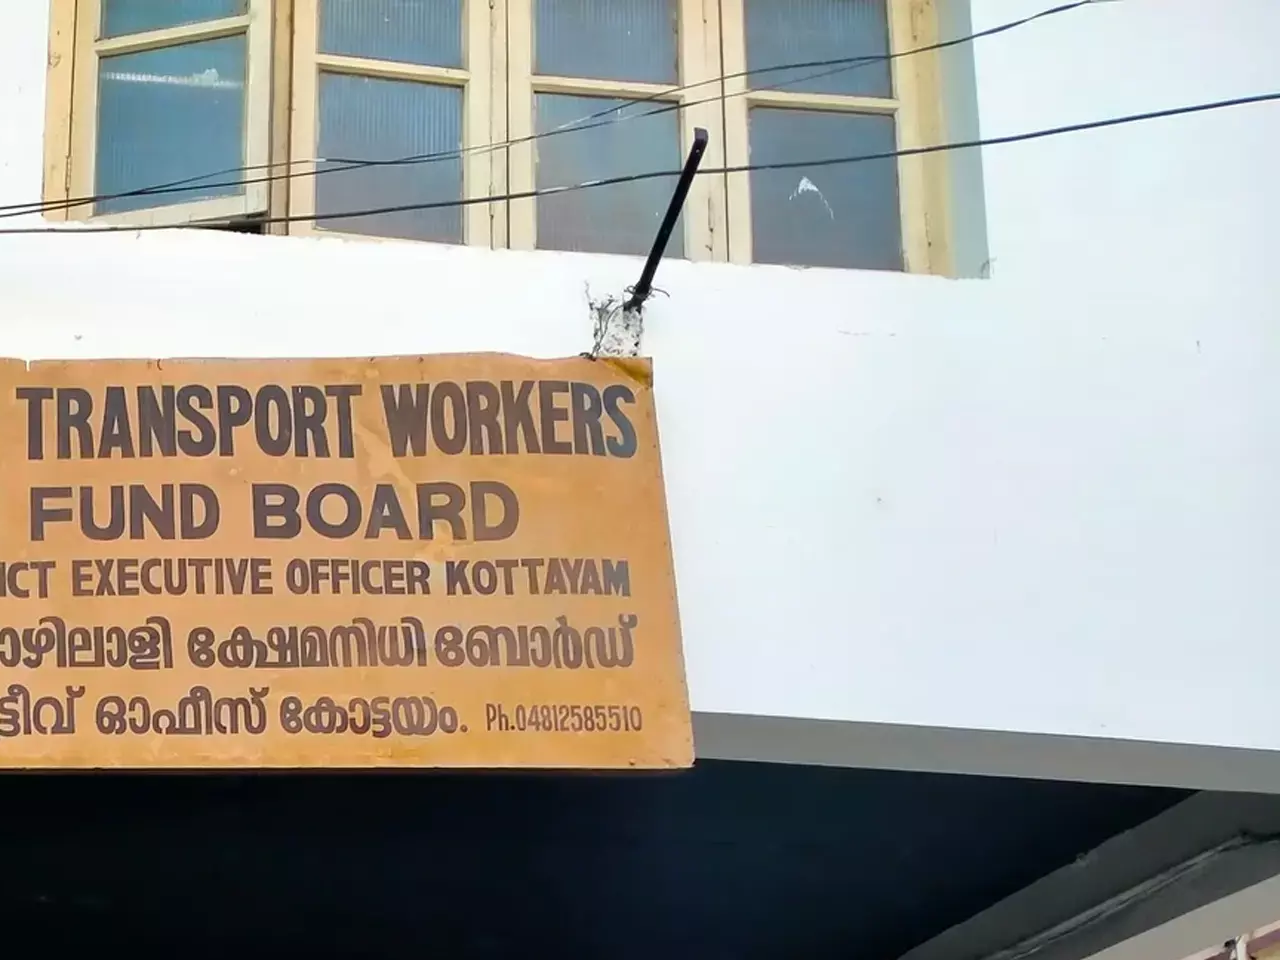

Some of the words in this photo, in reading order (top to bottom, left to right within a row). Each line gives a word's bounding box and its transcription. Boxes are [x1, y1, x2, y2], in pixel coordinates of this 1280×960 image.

[16, 384, 362, 460] TRANSPORT
[381, 379, 637, 458] WORKERS
[30, 483, 220, 541] FUND
[252, 481, 519, 541] BOARD
[72, 558, 273, 596] EXECUTIVE
[286, 559, 430, 595] OFFICER
[446, 558, 630, 596] KOTTAYAM
[187, 617, 427, 668] ക്ഷേമനിധി
[435, 614, 637, 669] ബോർഡ്
[96, 686, 269, 735] ഓഫീസ്
[280, 696, 468, 738] കോട്ടയം.
[486, 704, 641, 731] Ph.04812585510
